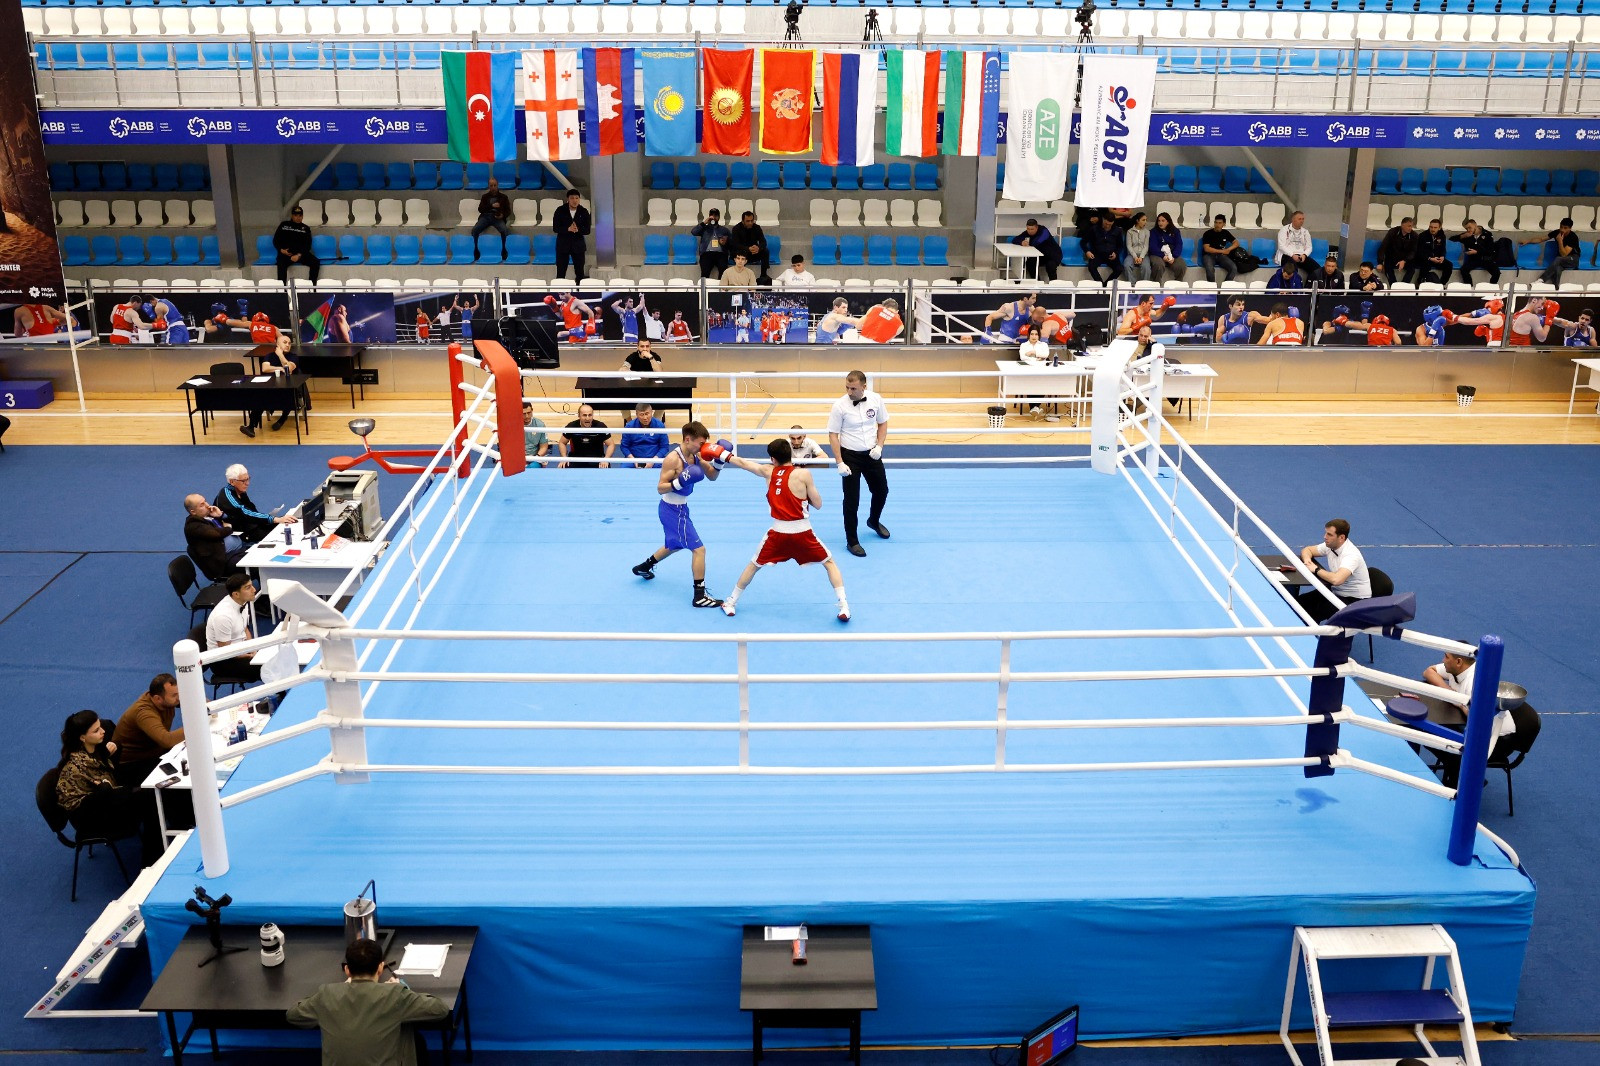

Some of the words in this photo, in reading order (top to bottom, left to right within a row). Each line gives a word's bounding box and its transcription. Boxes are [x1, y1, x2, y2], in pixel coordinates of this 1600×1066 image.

[42, 122, 65, 131] ABB
[130, 121, 154, 131] ABB
[208, 121, 232, 131] ABB
[297, 121, 321, 130] ABB
[386, 121, 410, 130] ABB
[1039, 109, 1055, 148] AZE
[1181, 125, 1205, 135] ABB
[1268, 126, 1292, 135] ABB
[1346, 126, 1370, 136] ABB
[1101, 114, 1130, 184] ABF
[1370, 327, 1389, 335] AZE
[4, 392, 16, 408] 3
